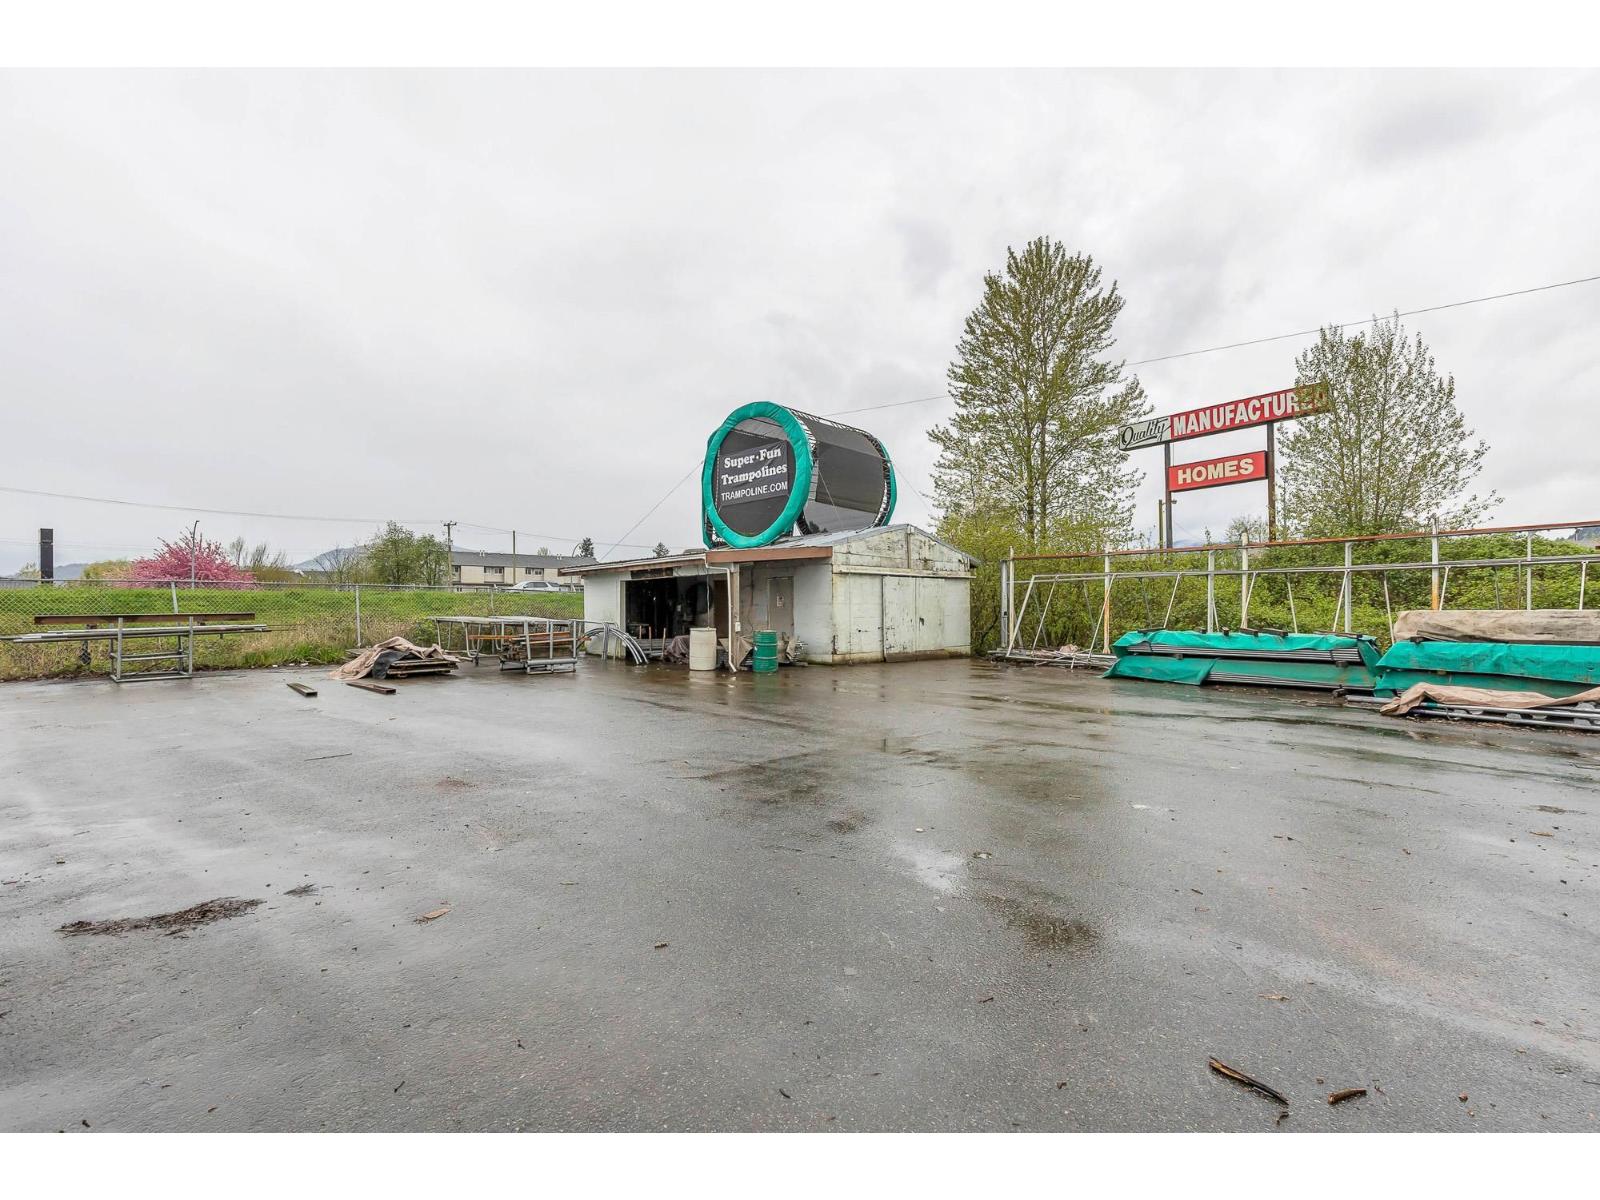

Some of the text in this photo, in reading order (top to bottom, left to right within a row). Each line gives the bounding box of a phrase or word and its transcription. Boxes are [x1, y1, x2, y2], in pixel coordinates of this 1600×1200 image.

[1121, 388, 1325, 448] Quality MANUFACTUR
[721, 464, 788, 485] Trampolines
[1177, 458, 1254, 485] HOMES
[721, 481, 788, 501] TRAMPOLINE.COM
